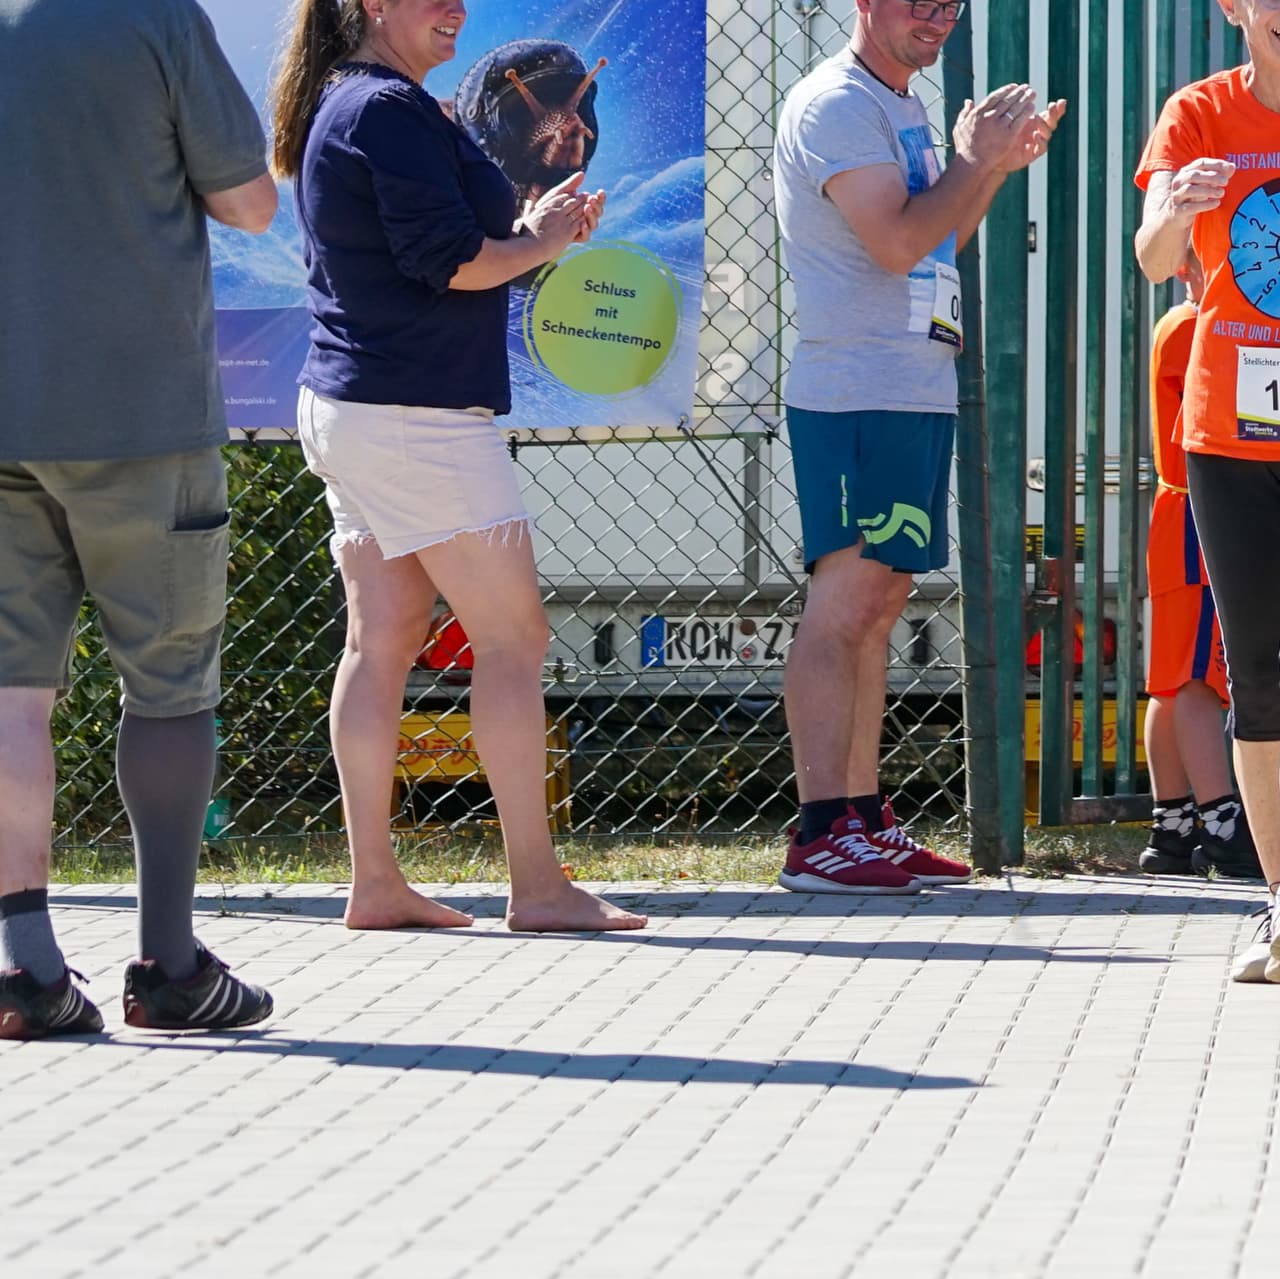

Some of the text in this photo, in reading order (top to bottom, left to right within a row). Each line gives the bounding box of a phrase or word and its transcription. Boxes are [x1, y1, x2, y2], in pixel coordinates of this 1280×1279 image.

[1269, 199, 1280, 215] 1
[1249, 218, 1266, 232] 2
[1242, 241, 1259, 249] 3
[1247, 262, 1262, 272] 4
[584, 279, 636, 299] Schluss
[595, 306, 618, 320] mit
[541, 320, 662, 351] Schneckentempo
[1213, 320, 1245, 338] ALTER
[1248, 324, 1271, 342] UND
[1243, 357, 1280, 367] Stellichter
[666, 621, 734, 661] ROW
[763, 621, 799, 661] Z
